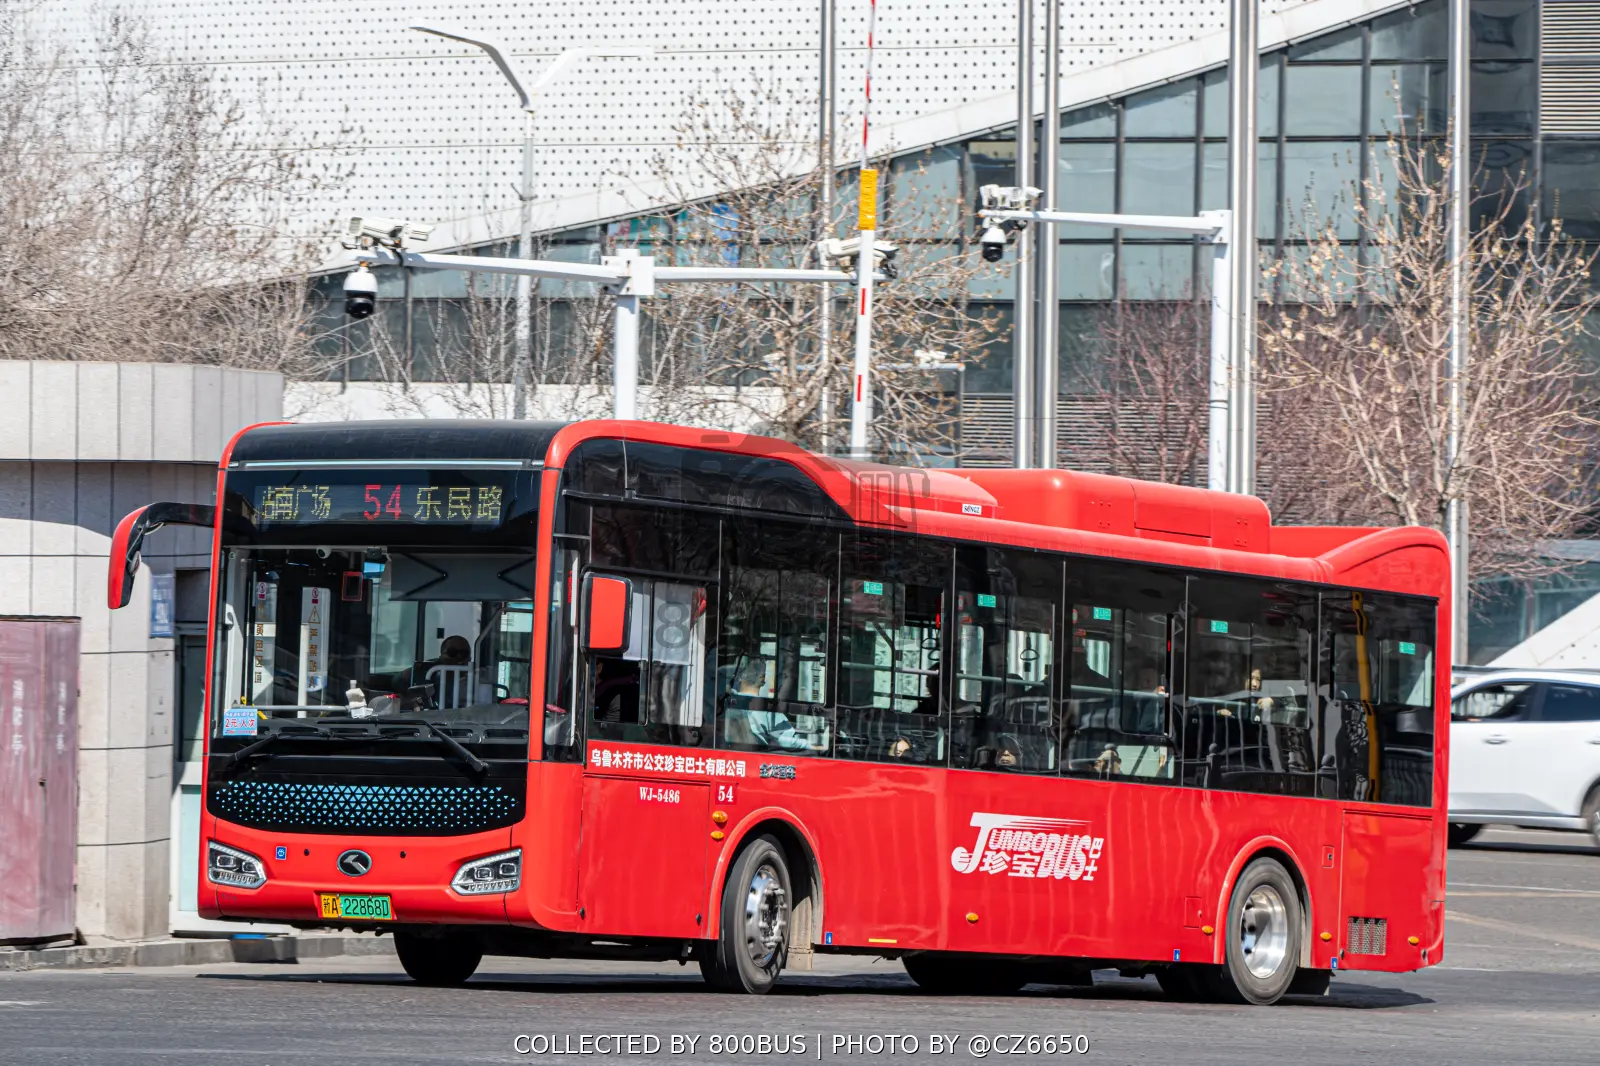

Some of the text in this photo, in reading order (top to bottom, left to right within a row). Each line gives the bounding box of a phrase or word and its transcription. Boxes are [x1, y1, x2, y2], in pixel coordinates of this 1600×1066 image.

[363, 484, 401, 520] 54
[413, 485, 503, 520] 乐民路
[591, 748, 746, 778] 乌鲁木齐市公交珍宝巴士有限公司
[639, 786, 680, 804] WJ-5486
[717, 785, 734, 802] 54
